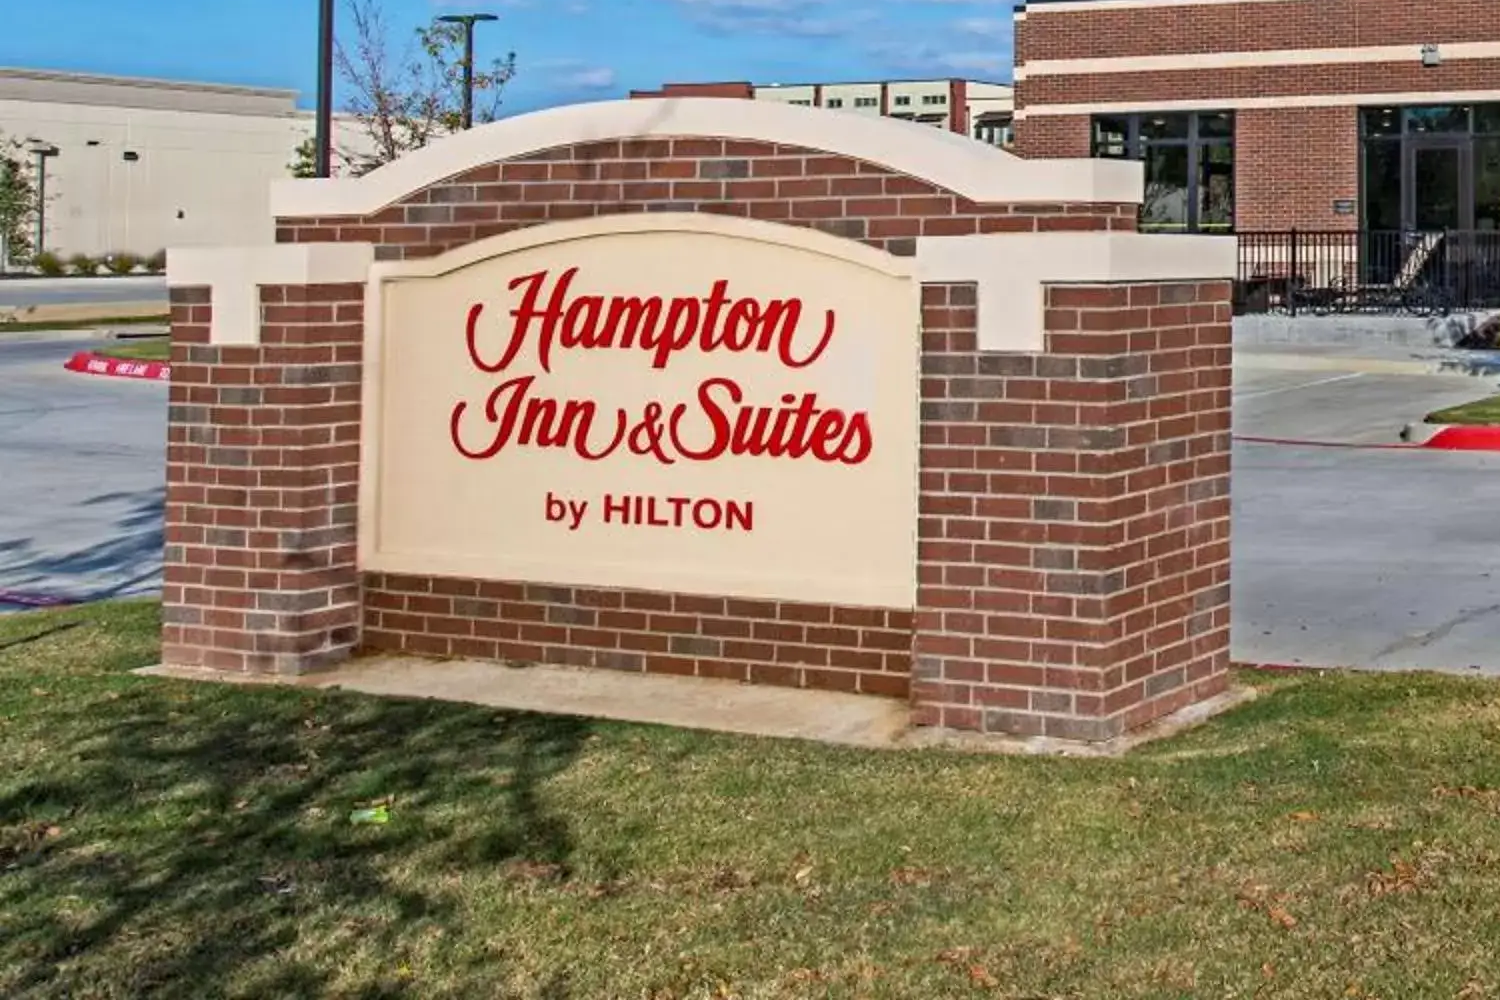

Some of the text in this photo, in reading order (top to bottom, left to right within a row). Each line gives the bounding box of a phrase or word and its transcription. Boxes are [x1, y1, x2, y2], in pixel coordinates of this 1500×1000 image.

[465, 267, 836, 373] Hampton
[450, 375, 873, 466] Inn & Suites
[544, 493, 754, 532] by HILTON
